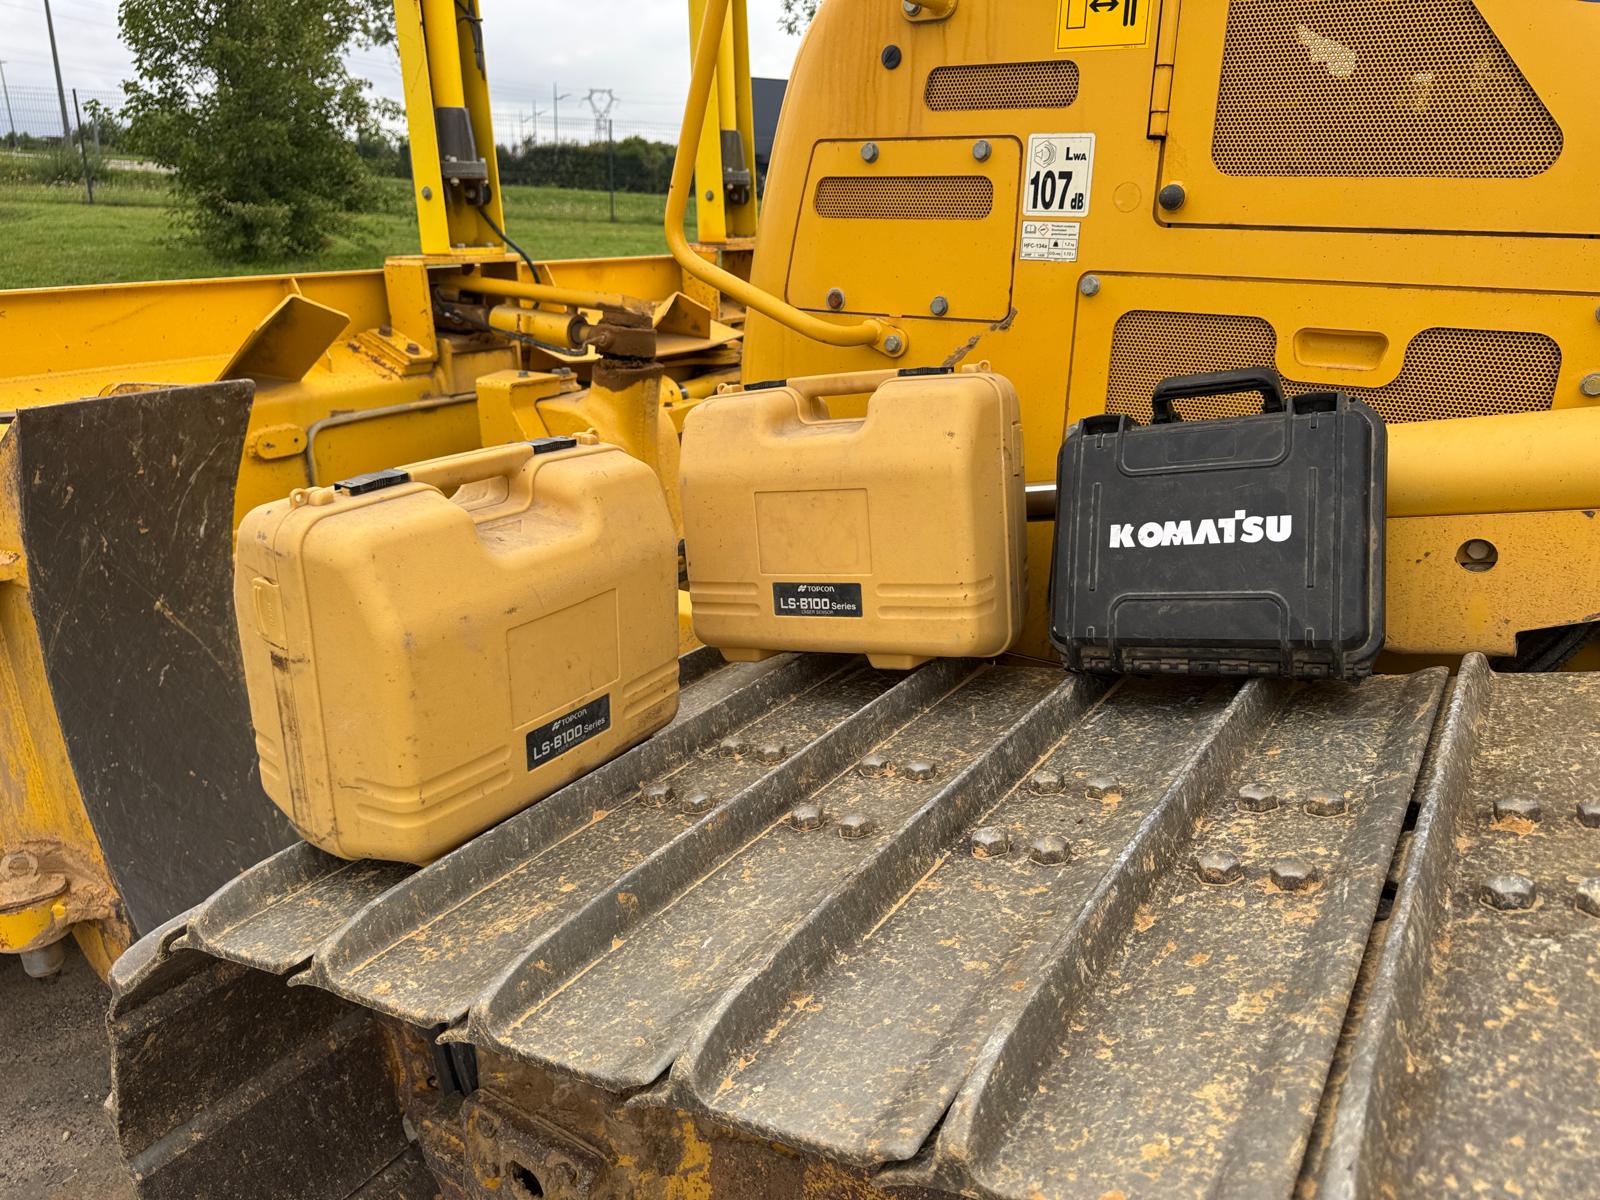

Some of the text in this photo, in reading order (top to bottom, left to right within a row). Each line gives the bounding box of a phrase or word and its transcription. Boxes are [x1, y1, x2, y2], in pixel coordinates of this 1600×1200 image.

[1030, 170, 1084, 210] 107 dB
[1109, 509, 1293, 549] KOMATSU
[807, 585, 835, 593] TOPCON
[831, 601, 857, 611] Series
[583, 716, 606, 734] Series
